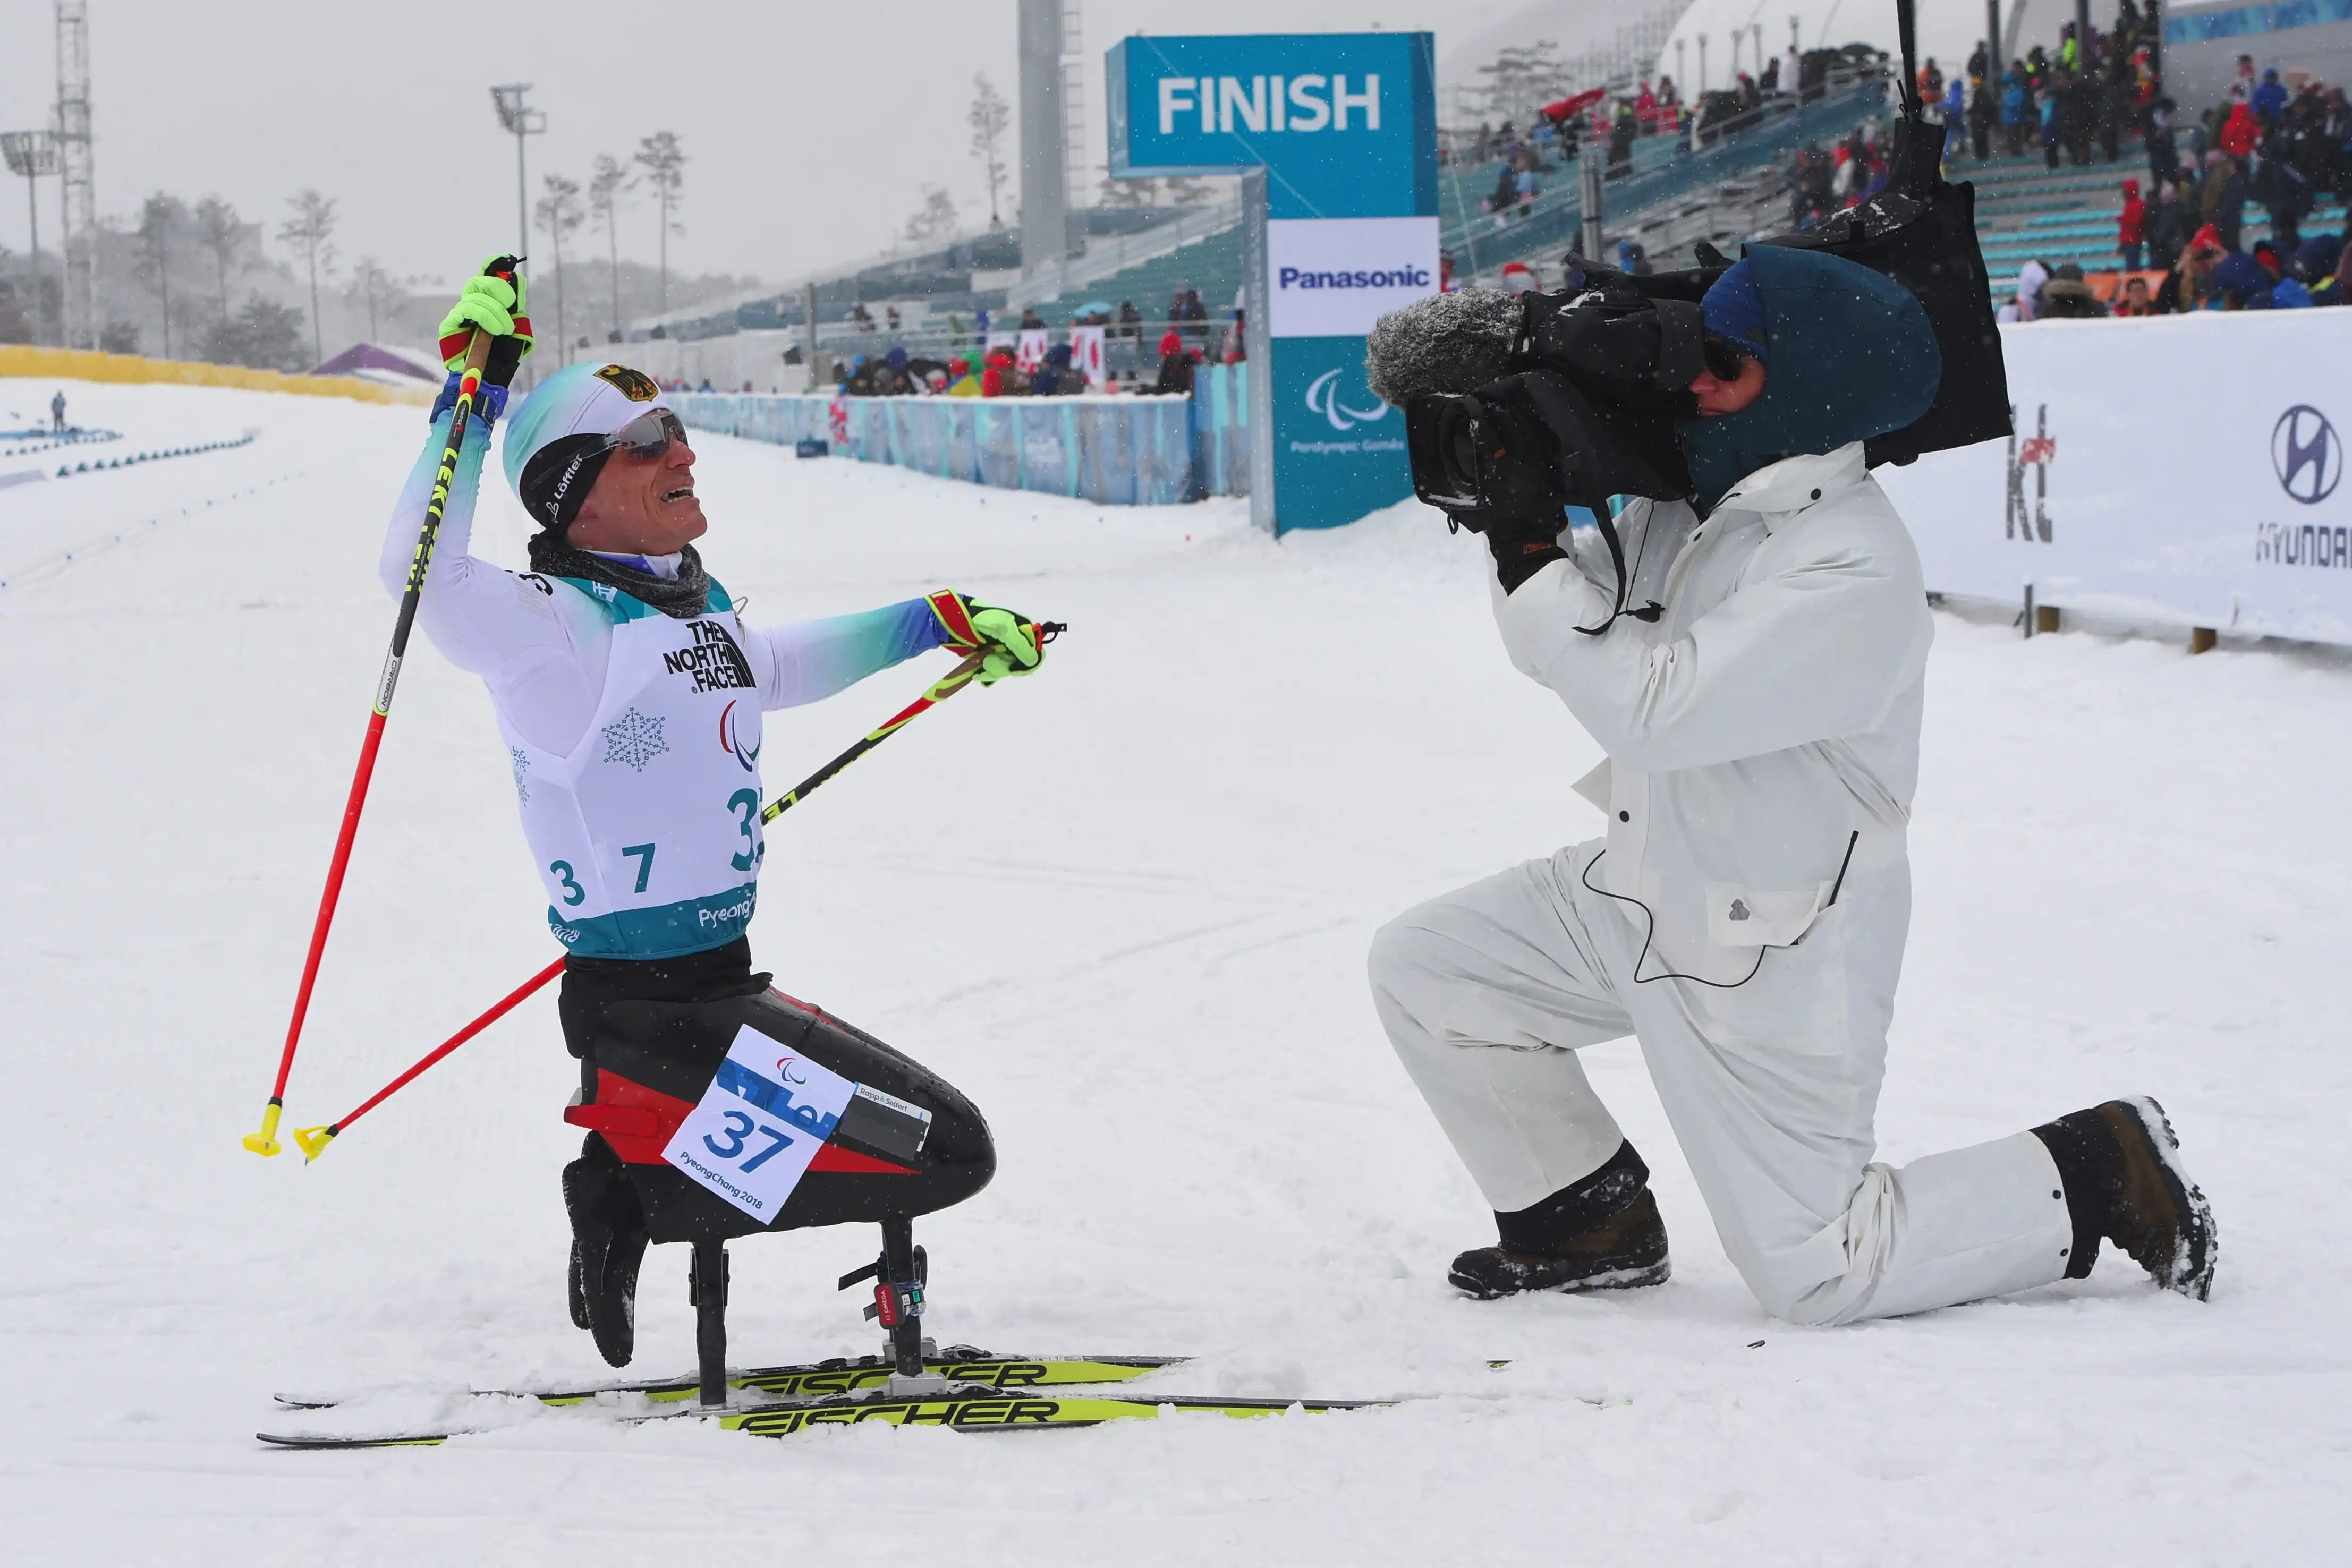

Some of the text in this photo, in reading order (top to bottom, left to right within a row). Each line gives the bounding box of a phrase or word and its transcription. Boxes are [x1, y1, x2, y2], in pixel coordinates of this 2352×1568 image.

[1158, 74, 1380, 134] FINISH
[1279, 265, 1430, 289] Panasonic
[428, 447, 458, 521] LEKI
[2256, 522, 2352, 569] HYUNDA
[685, 620, 724, 645] THE
[663, 643, 731, 675] NORTH
[692, 666, 739, 693] FACE
[381, 660, 397, 707] CARBON
[727, 788, 765, 871] 3
[703, 1110, 795, 1174] 37
[680, 1151, 763, 1209] PyeongChang 2018
